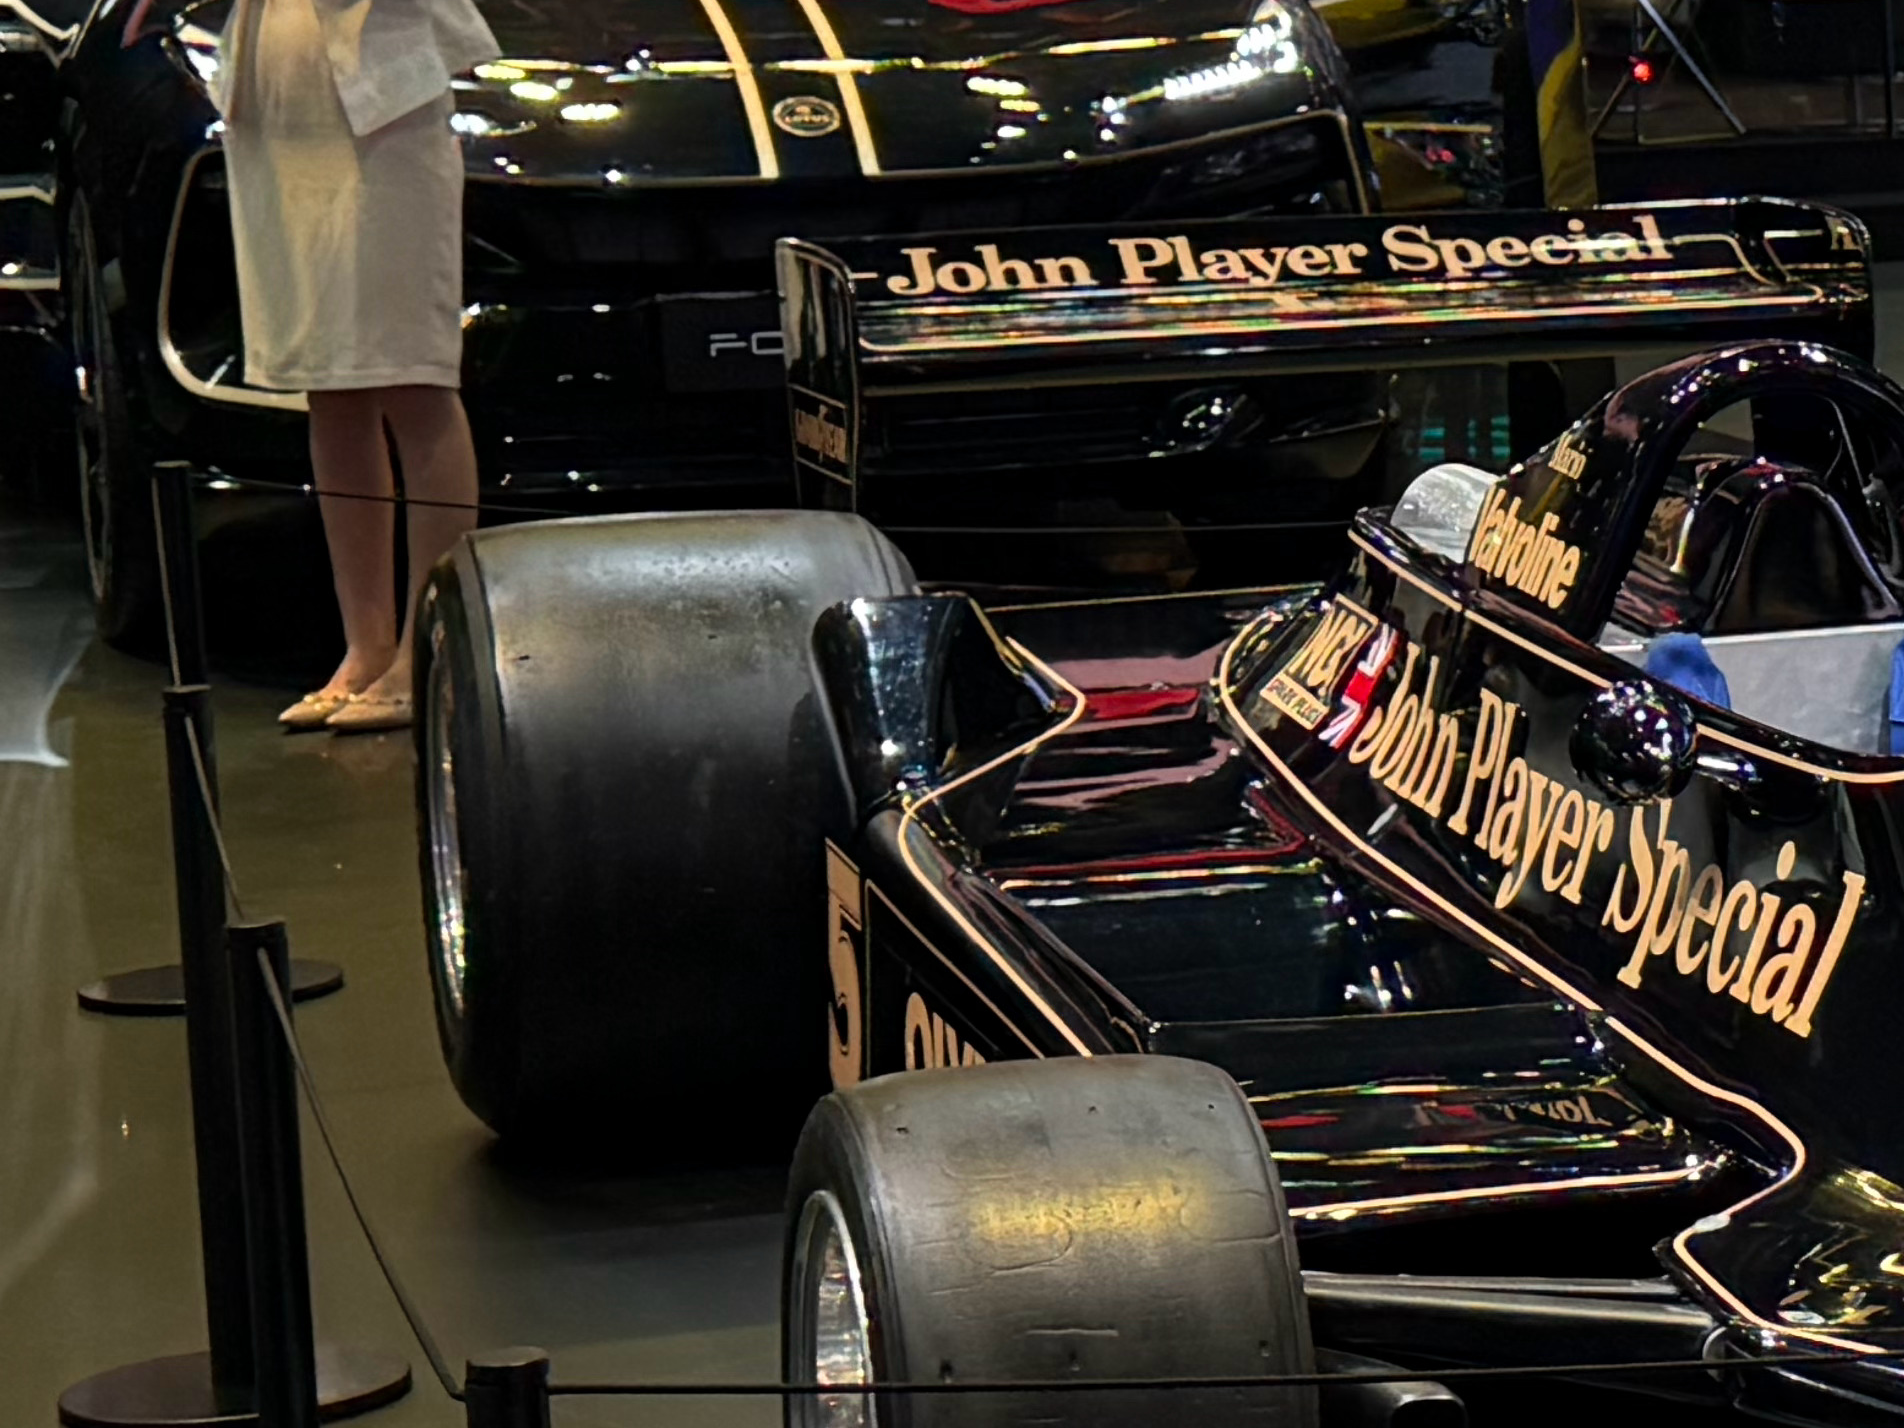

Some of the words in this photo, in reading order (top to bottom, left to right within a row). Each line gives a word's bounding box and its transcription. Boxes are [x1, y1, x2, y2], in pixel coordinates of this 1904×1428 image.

[886, 244, 1098, 297] John
[1109, 234, 1371, 287] Player
[1383, 215, 1674, 278] Special
[1468, 482, 1581, 609] Valvoline
[1349, 642, 1459, 818] John
[1447, 687, 1615, 910] Player
[1602, 798, 1866, 1038] Special
